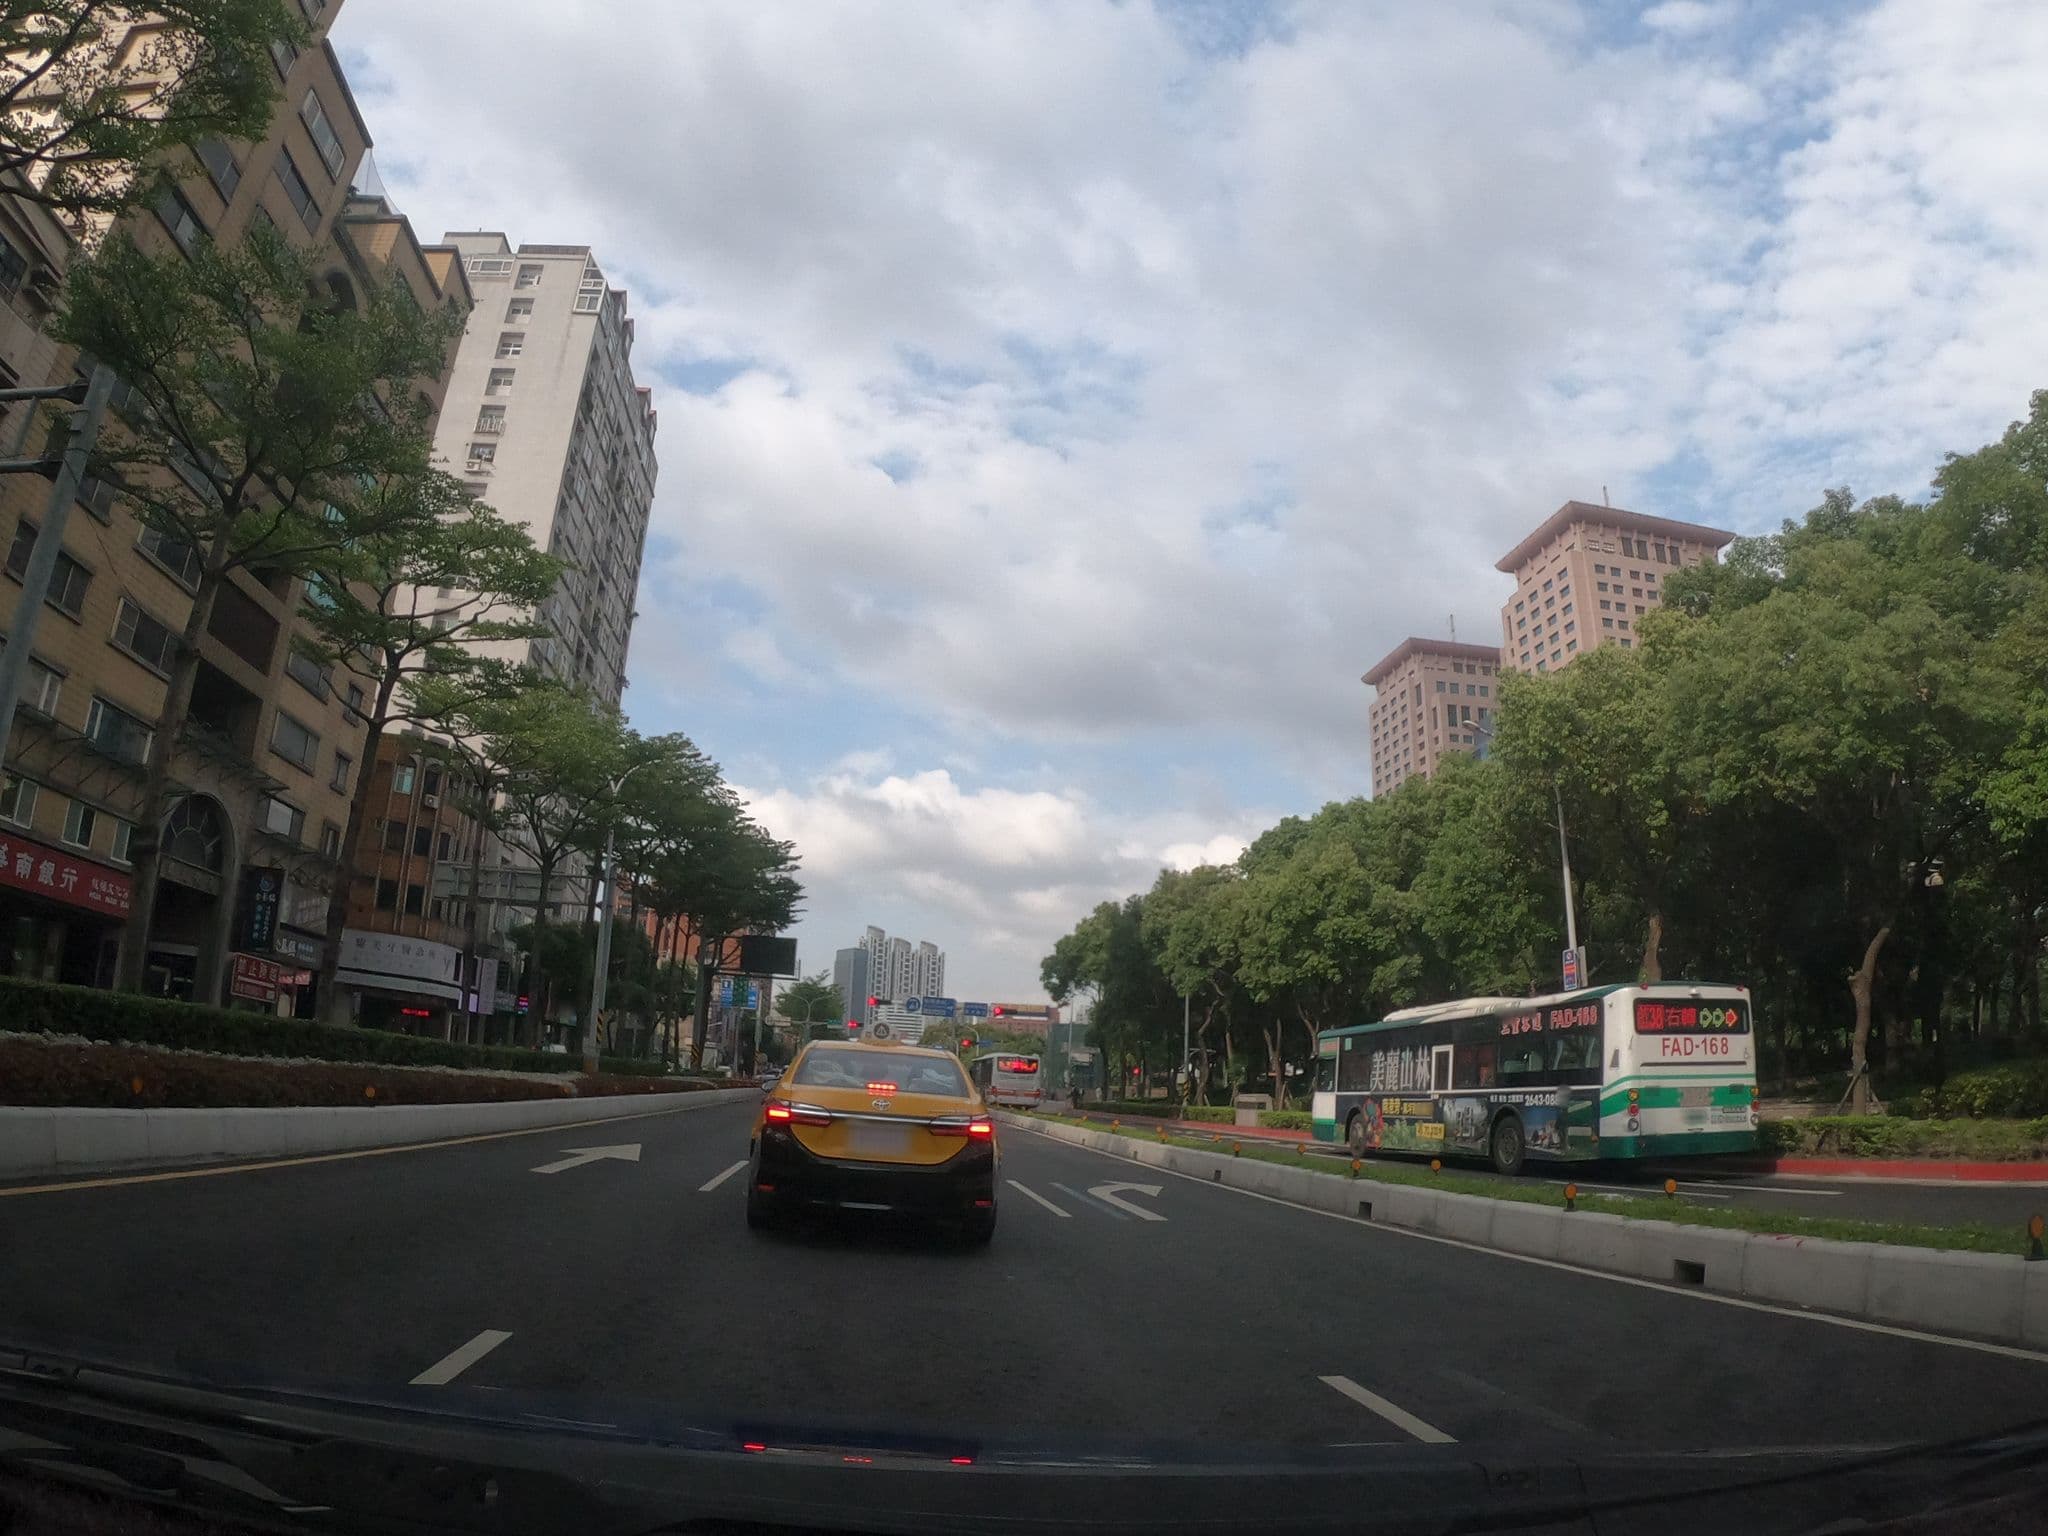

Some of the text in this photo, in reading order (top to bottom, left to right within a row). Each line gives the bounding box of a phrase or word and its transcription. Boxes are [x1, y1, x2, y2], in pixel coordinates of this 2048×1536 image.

[1661, 1036, 1729, 1057] FAD-168
[1369, 1045, 1431, 1093] 美麗山林
